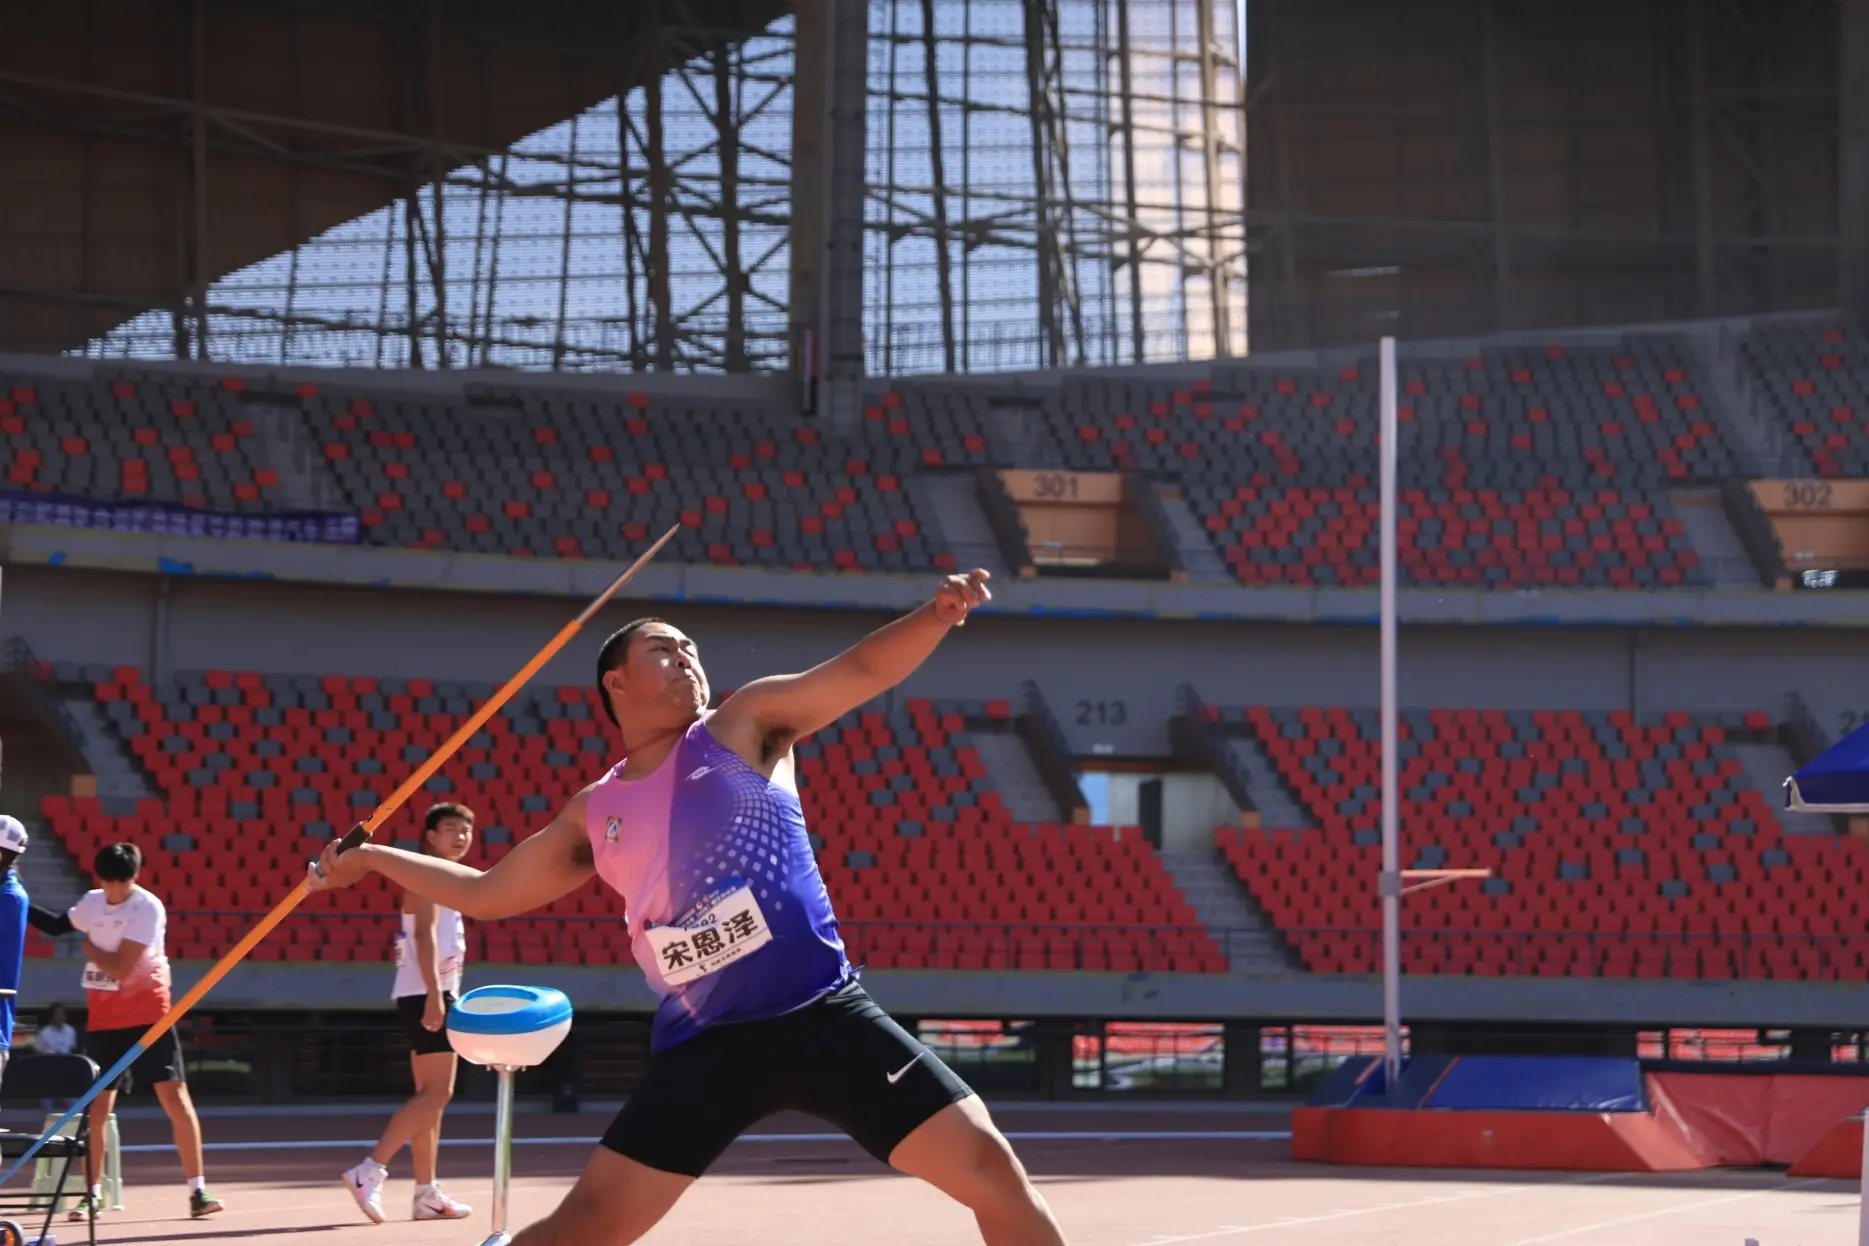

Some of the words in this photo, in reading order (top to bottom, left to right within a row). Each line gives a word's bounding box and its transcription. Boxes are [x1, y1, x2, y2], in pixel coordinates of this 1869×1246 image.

[1034, 472, 1078, 498] 301
[1783, 481, 1832, 510] 302
[1075, 699, 1127, 728] 213
[1839, 709, 1869, 737] 2
[661, 909, 758, 970] 宋恩泽
